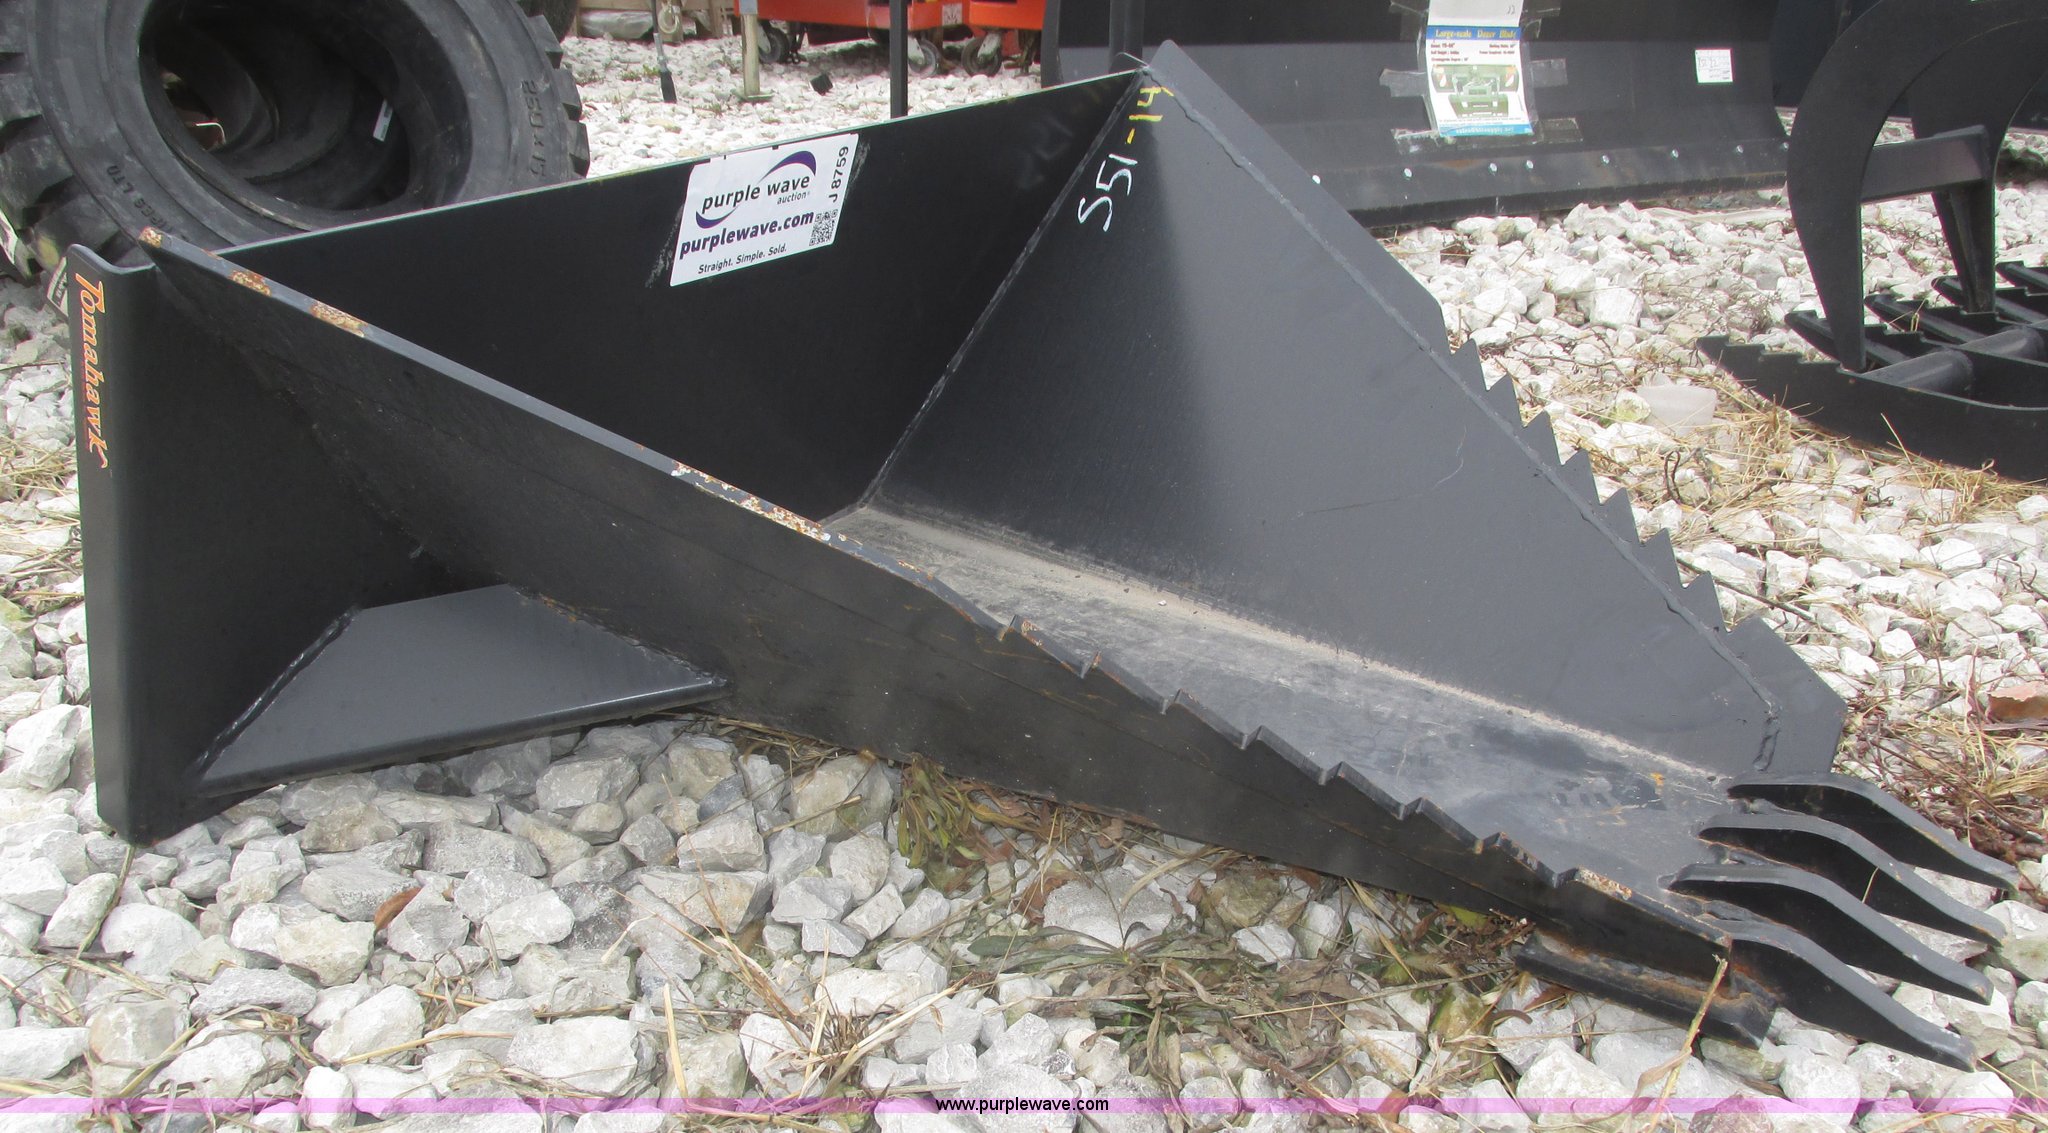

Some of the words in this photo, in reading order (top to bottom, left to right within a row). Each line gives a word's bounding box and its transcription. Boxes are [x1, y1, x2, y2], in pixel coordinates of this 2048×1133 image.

[830, 146, 849, 190] 8759
[702, 184, 760, 214] purple
[767, 175, 810, 197] wave
[828, 193, 838, 203] J
[679, 211, 815, 259] purplewave.com
[698, 257, 734, 274] Straight.
[736, 252, 766, 265] Simple.
[768, 243, 787, 256] Sold.
[75, 273, 109, 469] Tomahawk
